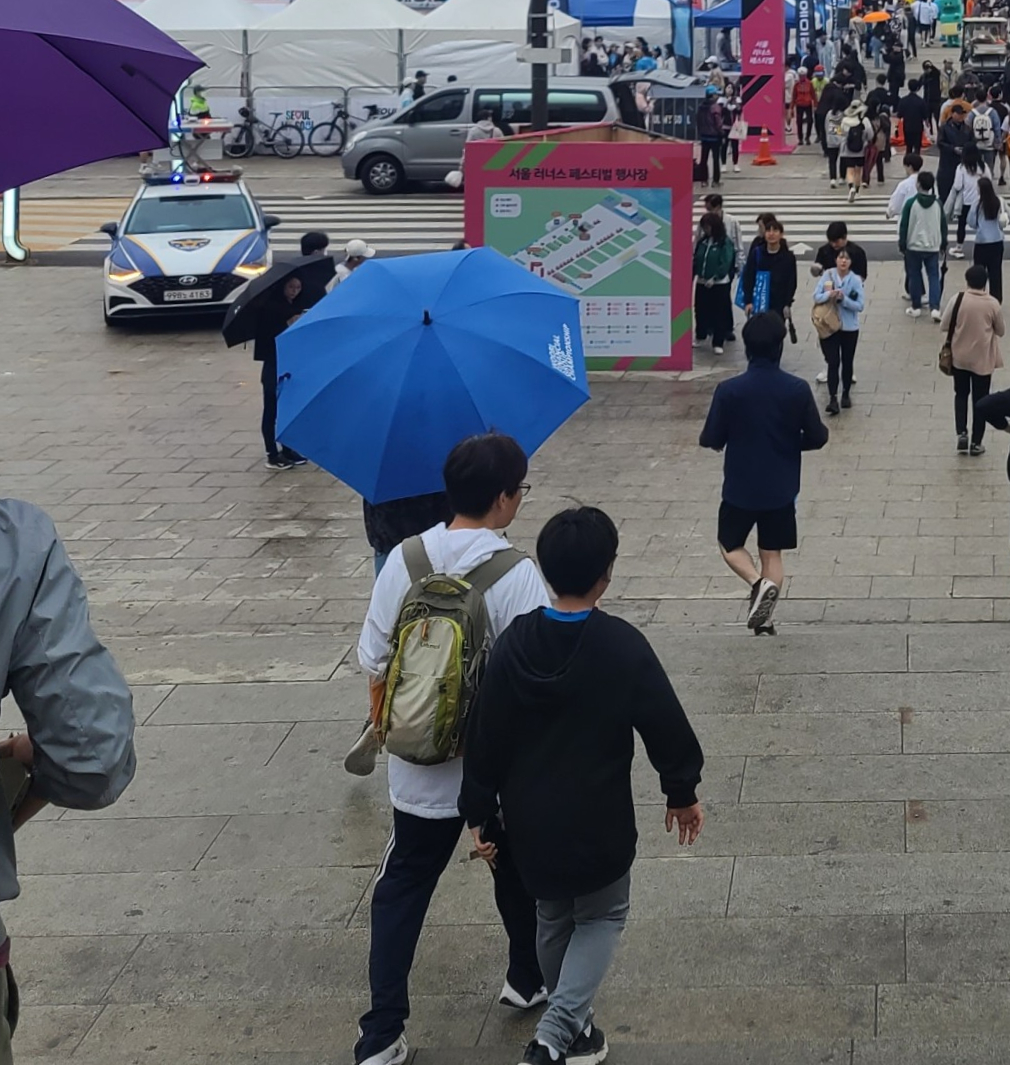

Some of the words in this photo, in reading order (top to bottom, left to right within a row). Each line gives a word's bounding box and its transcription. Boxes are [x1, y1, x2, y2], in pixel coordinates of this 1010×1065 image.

[285, 110, 311, 121] SEOUL
[509, 168, 531, 180] 서울
[535, 167, 566, 180] 러너스
[569, 168, 612, 181] 페스티벌
[616, 168, 648, 181] 행사장
